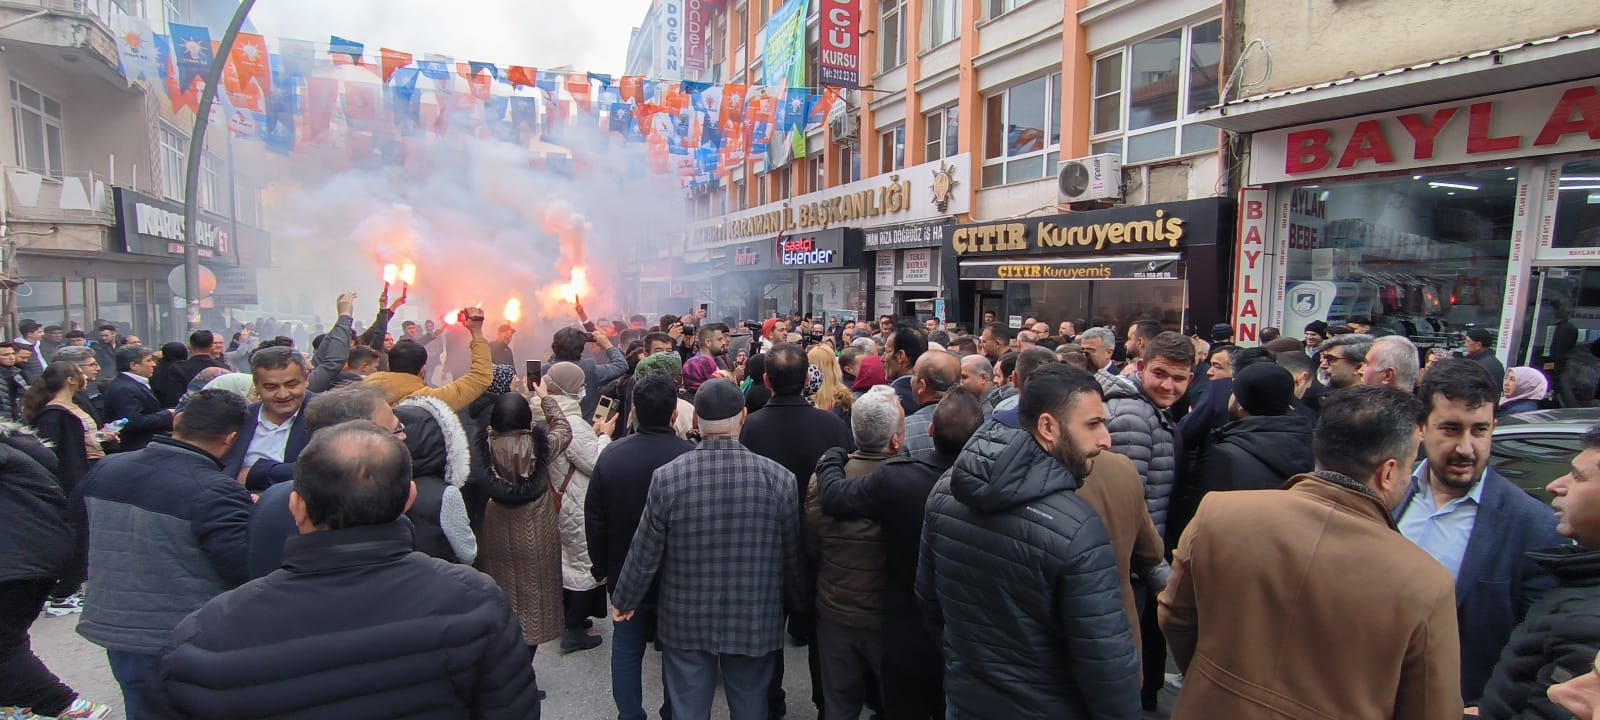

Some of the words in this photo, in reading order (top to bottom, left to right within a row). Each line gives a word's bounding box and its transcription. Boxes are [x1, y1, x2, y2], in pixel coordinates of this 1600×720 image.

[667, 3, 677, 71] DOĞAN
[823, 49, 856, 68] KURSU
[727, 210, 780, 240] KARAMAN
[783, 203, 796, 230] İL
[800, 174, 910, 229] BAŞKANLIĞI
[952, 222, 1028, 255] ÇITIR
[1037, 209, 1183, 249] Kuruyemiş
[1289, 223, 1318, 250] BEBE
[997, 264, 1041, 279] ÇITIR
[1042, 264, 1111, 280] Kuruyemiş
[1239, 200, 1263, 342] BAYLAN
